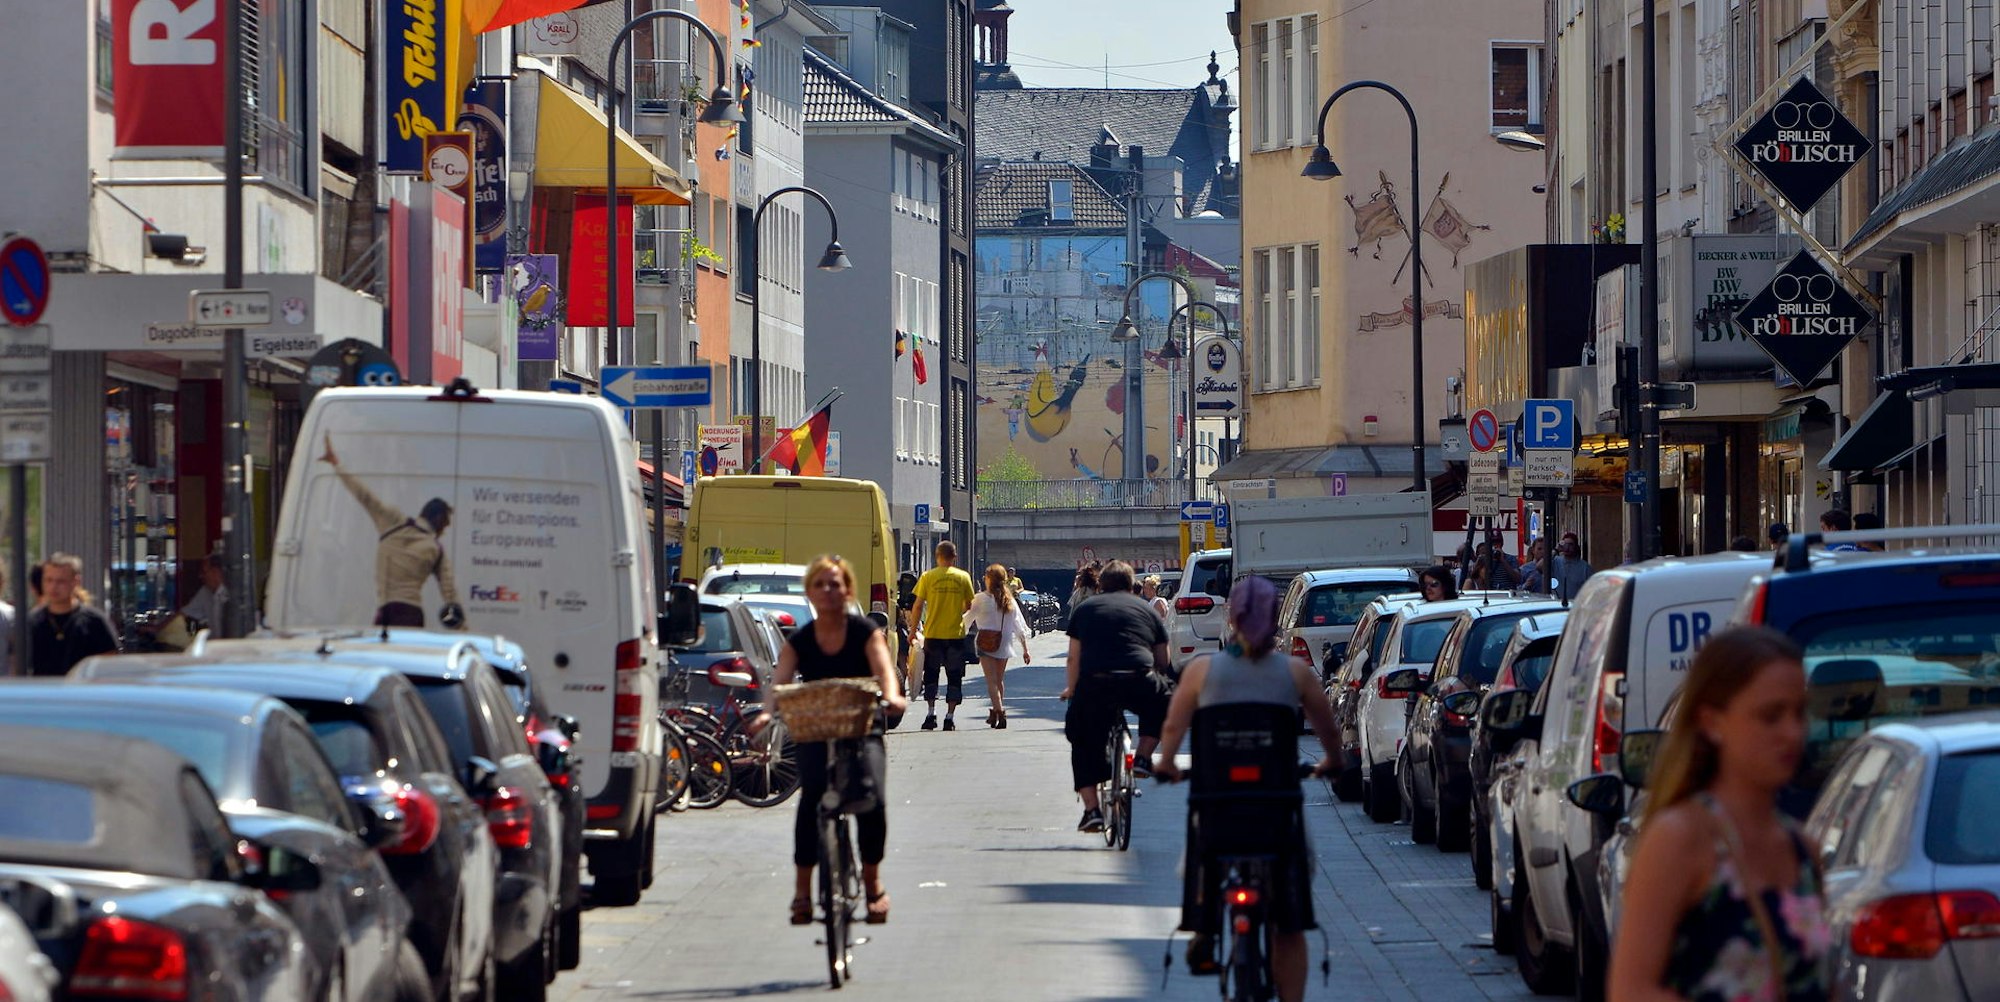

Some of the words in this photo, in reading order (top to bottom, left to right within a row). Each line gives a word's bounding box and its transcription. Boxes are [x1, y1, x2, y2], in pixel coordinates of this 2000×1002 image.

[1778, 130, 1831, 143] BRILLEN
[579, 221, 629, 237] KRL
[1698, 251, 1738, 261] BECKER
[1740, 252, 1748, 260] &
[1749, 251, 1777, 261] WELT
[1717, 267, 1739, 279] BW
[1713, 279, 1742, 293] BW
[1778, 303, 1831, 315] BRILLEN
[253, 337, 318, 355] Eigelstein
[633, 381, 706, 393] Einbahnstraße
[1536, 405, 1562, 443] P
[1471, 457, 1497, 468] Ladezone
[1335, 477, 1344, 497] P
[473, 487, 499, 502] Wir
[502, 491, 580, 506] versenden
[472, 508, 491, 523] für
[496, 509, 580, 528] Champions.
[917, 506, 926, 522] P
[1216, 507, 1225, 525] P
[1461, 512, 1519, 530] JUWE
[471, 530, 557, 549] Europaweit.
[470, 584, 519, 602] FedEx
